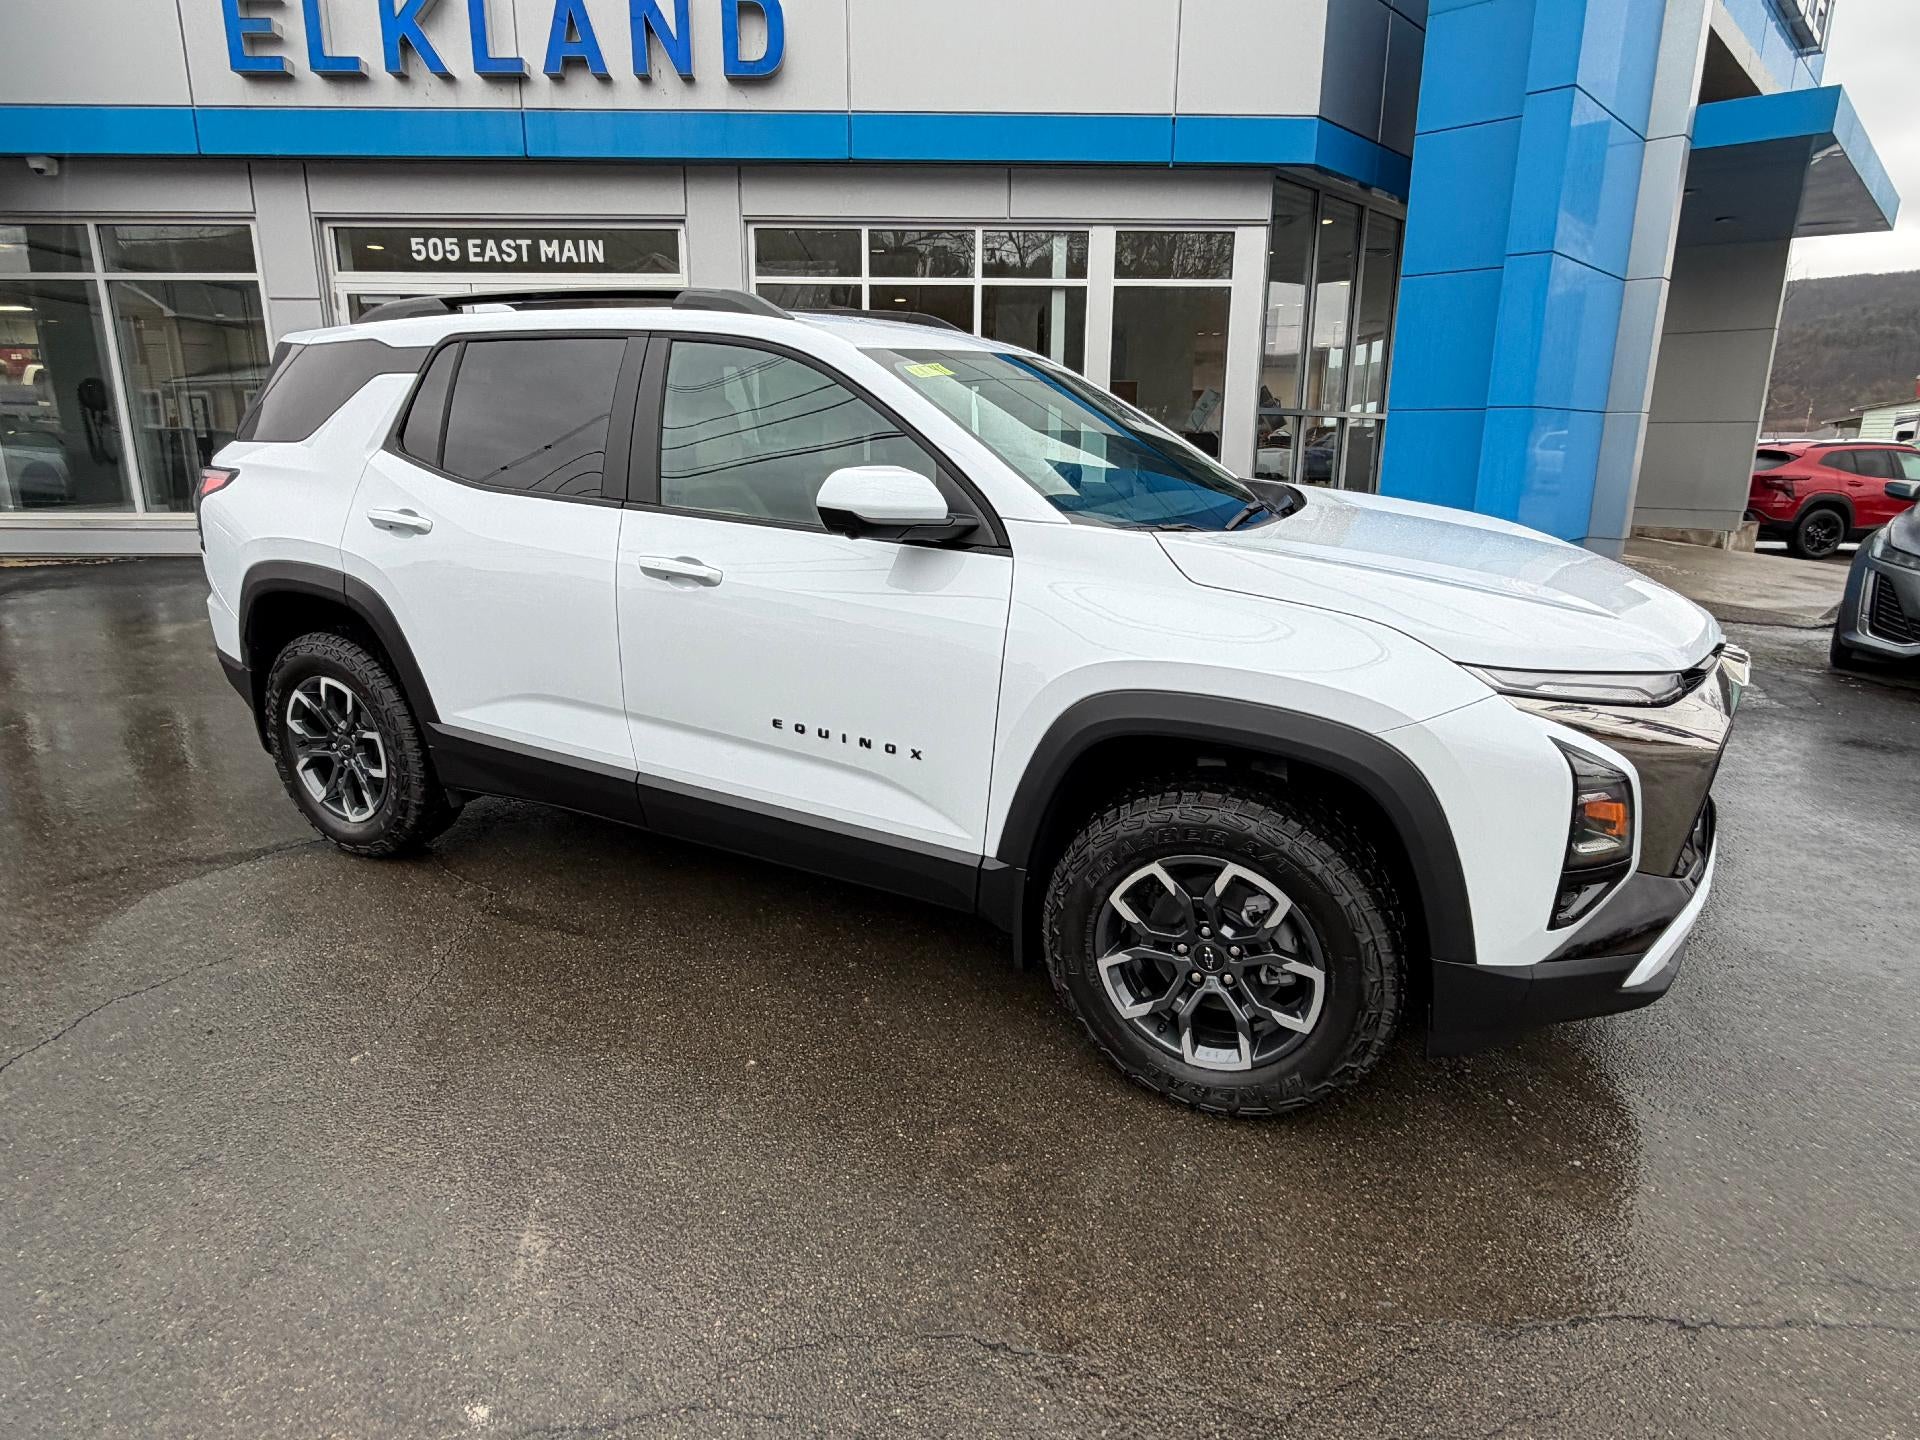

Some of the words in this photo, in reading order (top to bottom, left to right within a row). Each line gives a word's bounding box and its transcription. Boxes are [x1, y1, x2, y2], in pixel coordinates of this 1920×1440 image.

[224, 0, 786, 79] ELKLAND
[410, 237, 460, 261] 505
[467, 239, 531, 262] EAST
[539, 239, 604, 263] MAIN
[772, 718, 922, 760] EQUINOX
